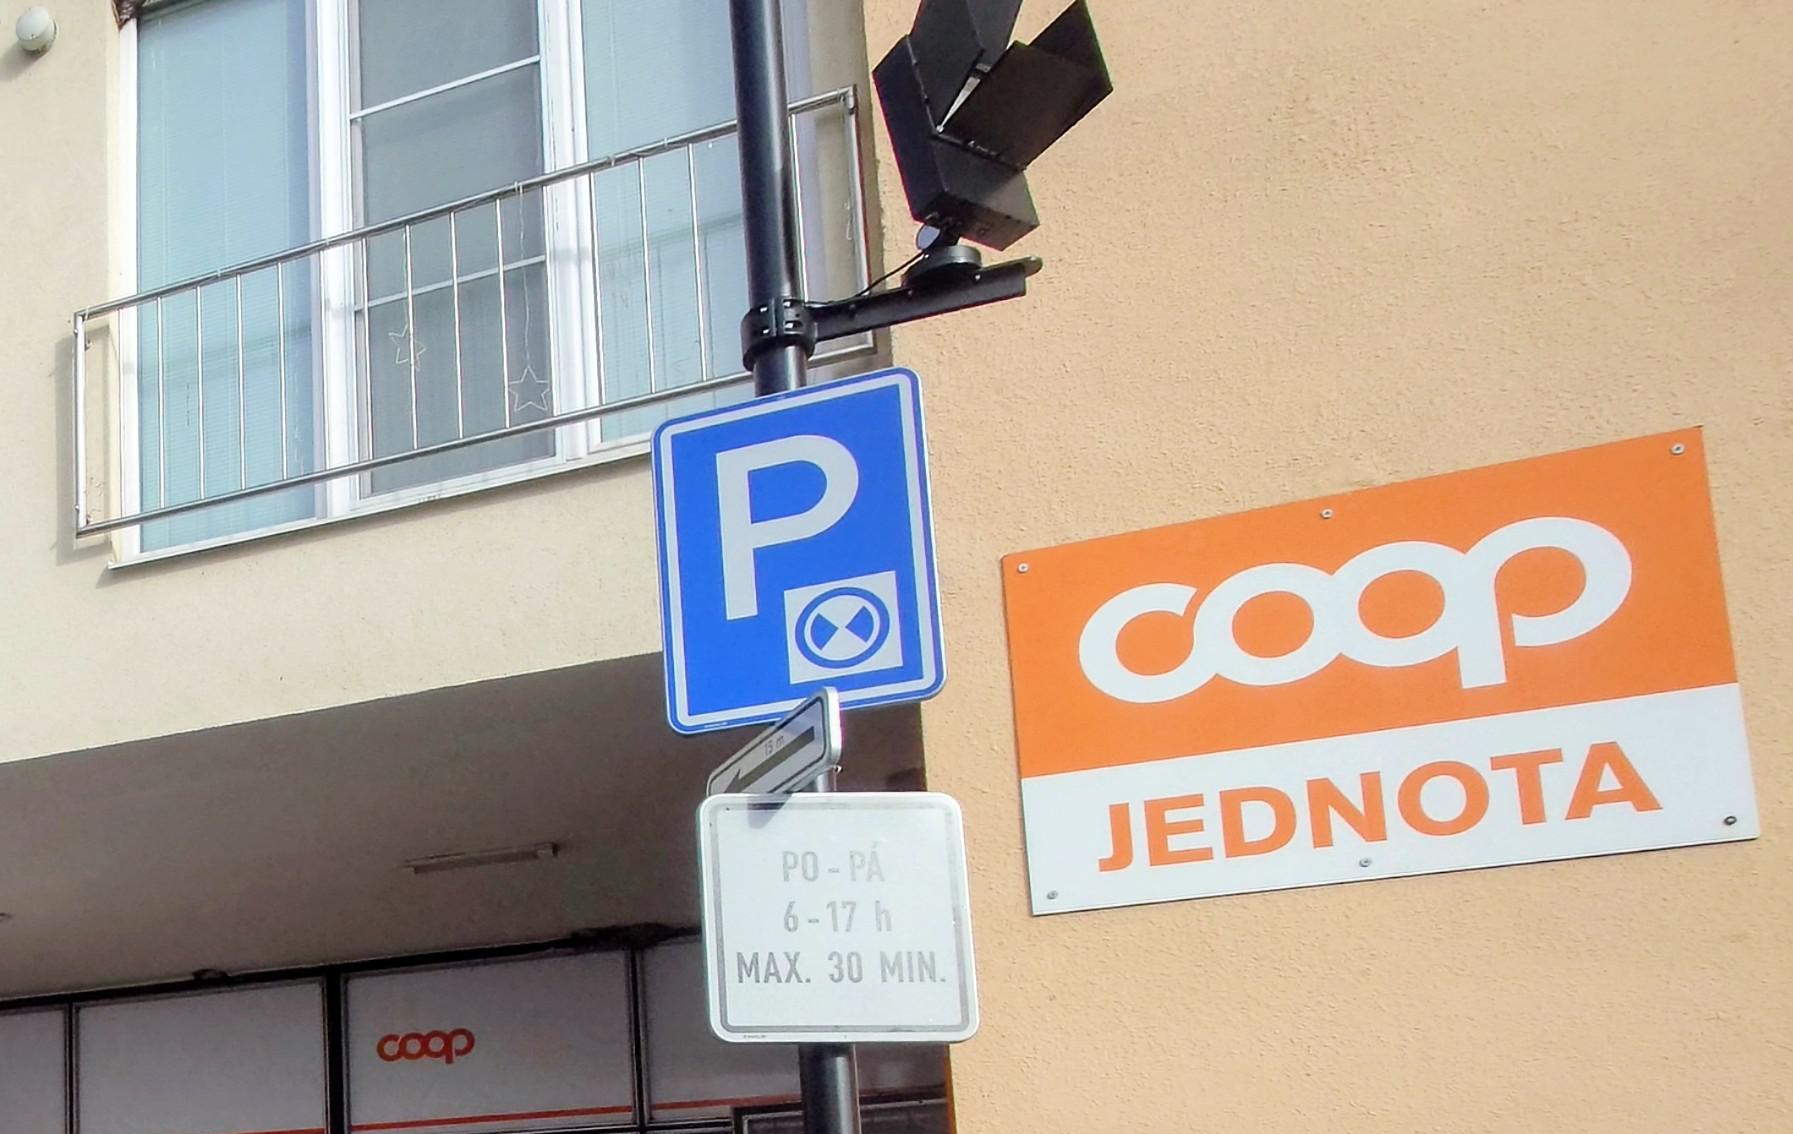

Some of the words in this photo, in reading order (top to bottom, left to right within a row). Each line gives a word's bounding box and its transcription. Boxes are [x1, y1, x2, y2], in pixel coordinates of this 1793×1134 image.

[714, 433, 860, 622] P
[1078, 515, 1634, 705] coop
[1098, 738, 1664, 874] JEDNOTA
[875, 900, 892, 932] h
[736, 951, 811, 983] MAX.
[828, 951, 863, 983] 30
[880, 951, 947, 983] MIN.
[376, 1027, 476, 1065] coop
